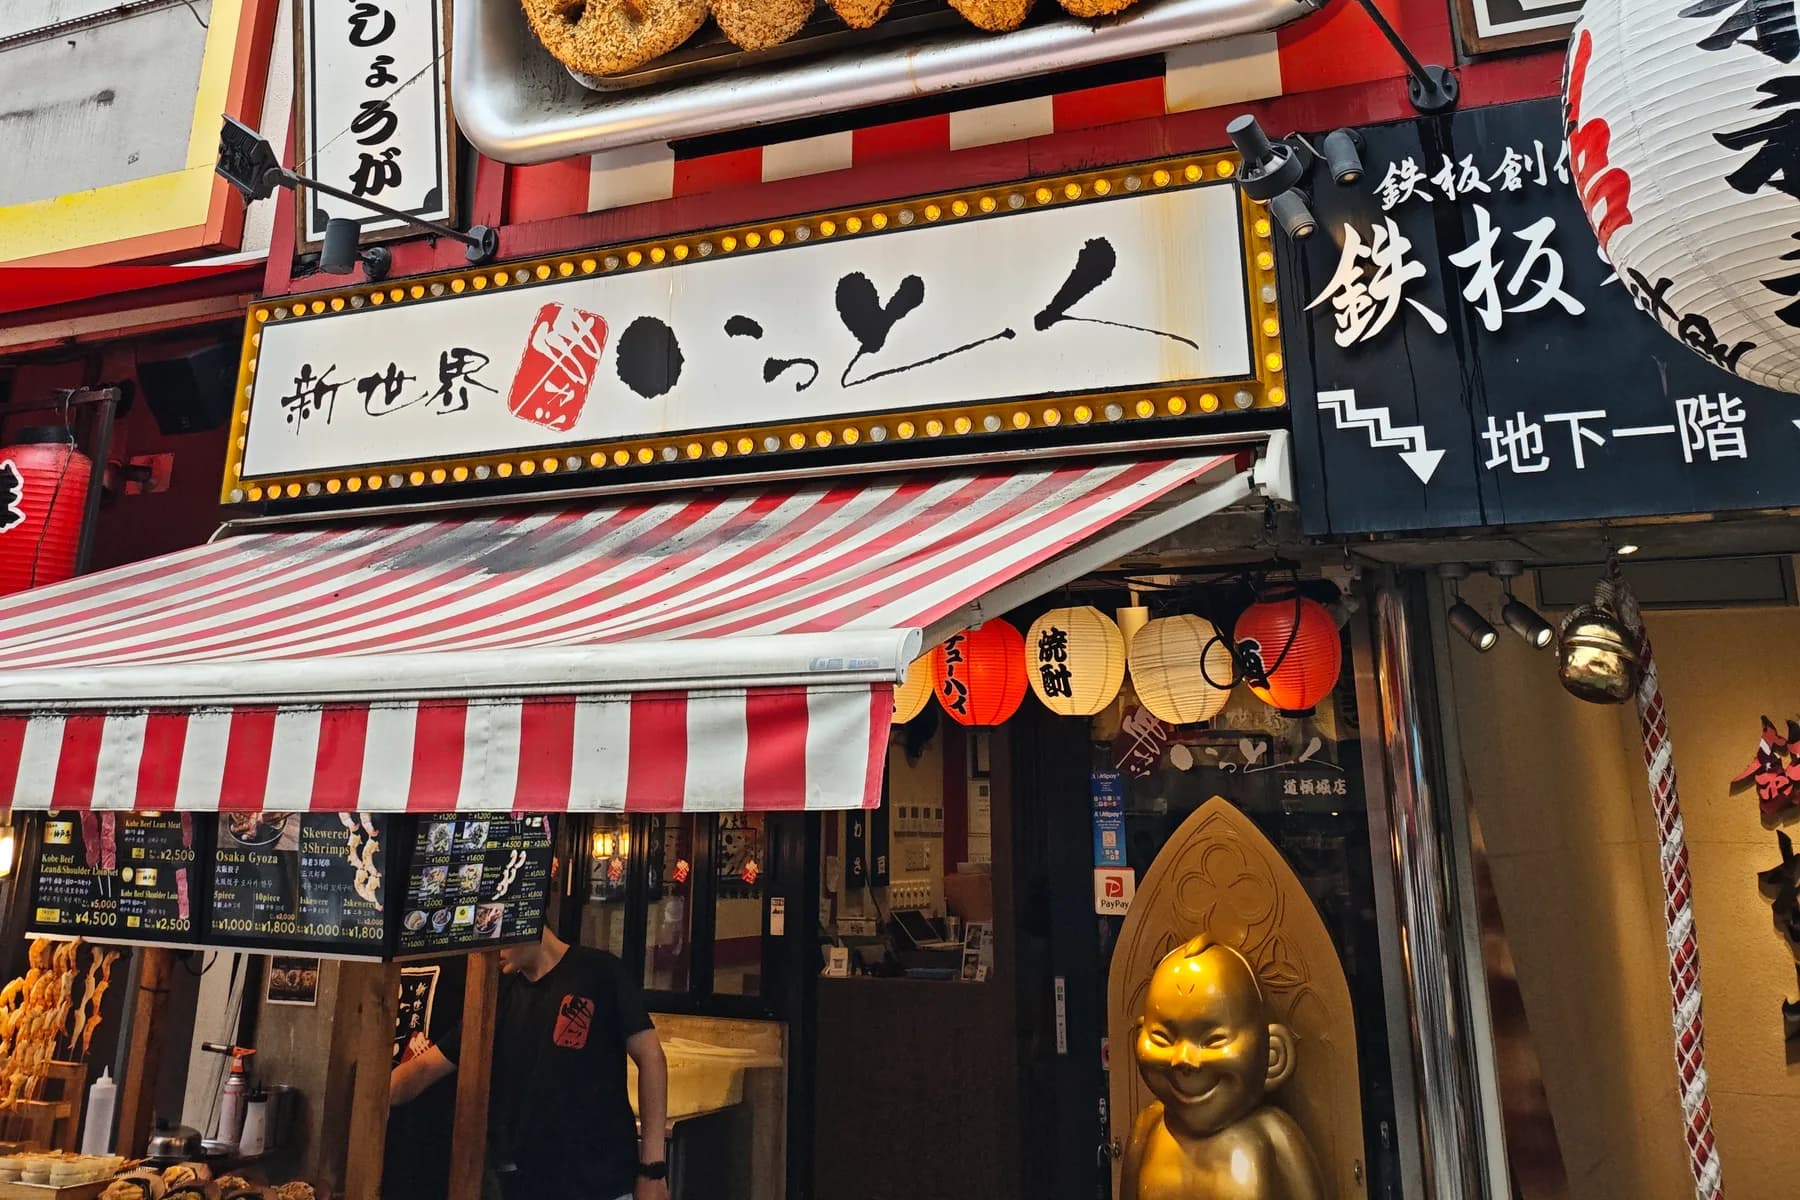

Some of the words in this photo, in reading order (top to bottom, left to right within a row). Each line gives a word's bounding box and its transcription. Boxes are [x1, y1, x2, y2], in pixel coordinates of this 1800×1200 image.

[1304, 204, 1625, 350] 鉄板
[281, 347, 499, 435] 新世界
[1481, 392, 1749, 474] 地下一階
[1038, 626, 1073, 698] 焼酎
[943, 634, 969, 715] チューハイ
[1283, 778, 1348, 796] 道頓堀店
[302, 826, 350, 840] Skewered
[160, 848, 195, 861] ¥2,500
[302, 842, 350, 858] 3Shrimps
[60, 854, 75, 864] Beef
[215, 850, 245, 863] Osaka
[248, 851, 278, 866] Gyoza
[213, 890, 236, 901] 5piece
[255, 892, 281, 903] 10piece
[91, 899, 117, 909] ¥5,000
[1101, 900, 1129, 910] PayPay
[75, 911, 117, 926] ¥4,500
[155, 918, 191, 932] ¥2,500
[218, 919, 253, 932] ¥1,000
[261, 921, 296, 934] ¥1,800
[303, 923, 340, 937] ¥1,000
[349, 926, 384, 940] ¥1,800
